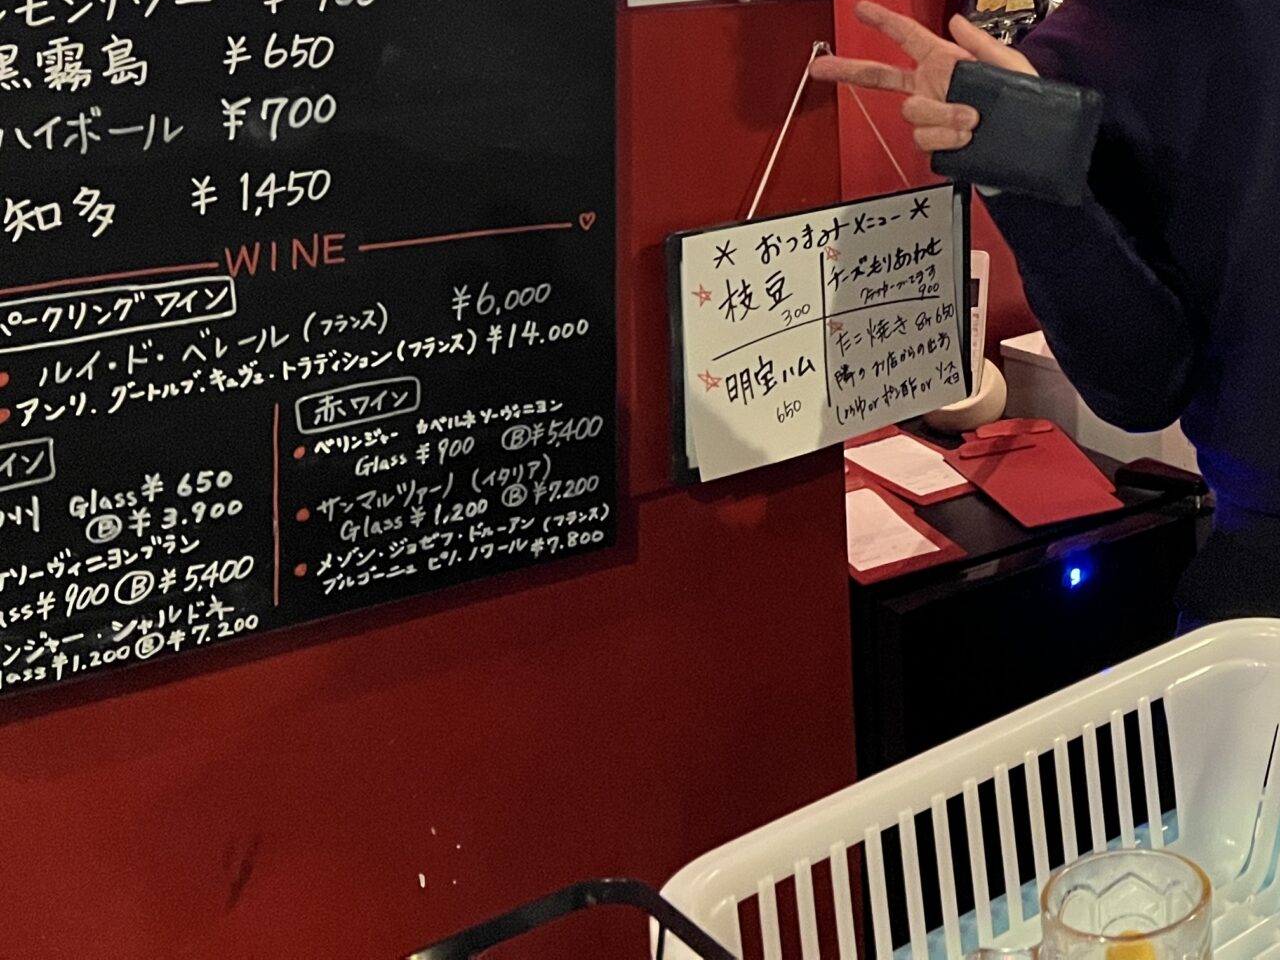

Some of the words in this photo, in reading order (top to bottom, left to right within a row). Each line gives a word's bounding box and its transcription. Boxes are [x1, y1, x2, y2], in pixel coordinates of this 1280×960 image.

[0, 34, 149, 92] 黒霧島
[4, 186, 116, 242] 知多
[224, 233, 346, 276] WINE
[718, 270, 793, 322] 枝豆
[781, 303, 811, 327] 300
[918, 282, 940, 300] 900
[725, 355, 816, 405] 明宝ハム
[314, 390, 409, 426] 赤ワイン
[776, 399, 802, 424] 650
[355, 453, 408, 477] Glass
[69, 488, 138, 520] Glass
[340, 516, 404, 543] Glass
